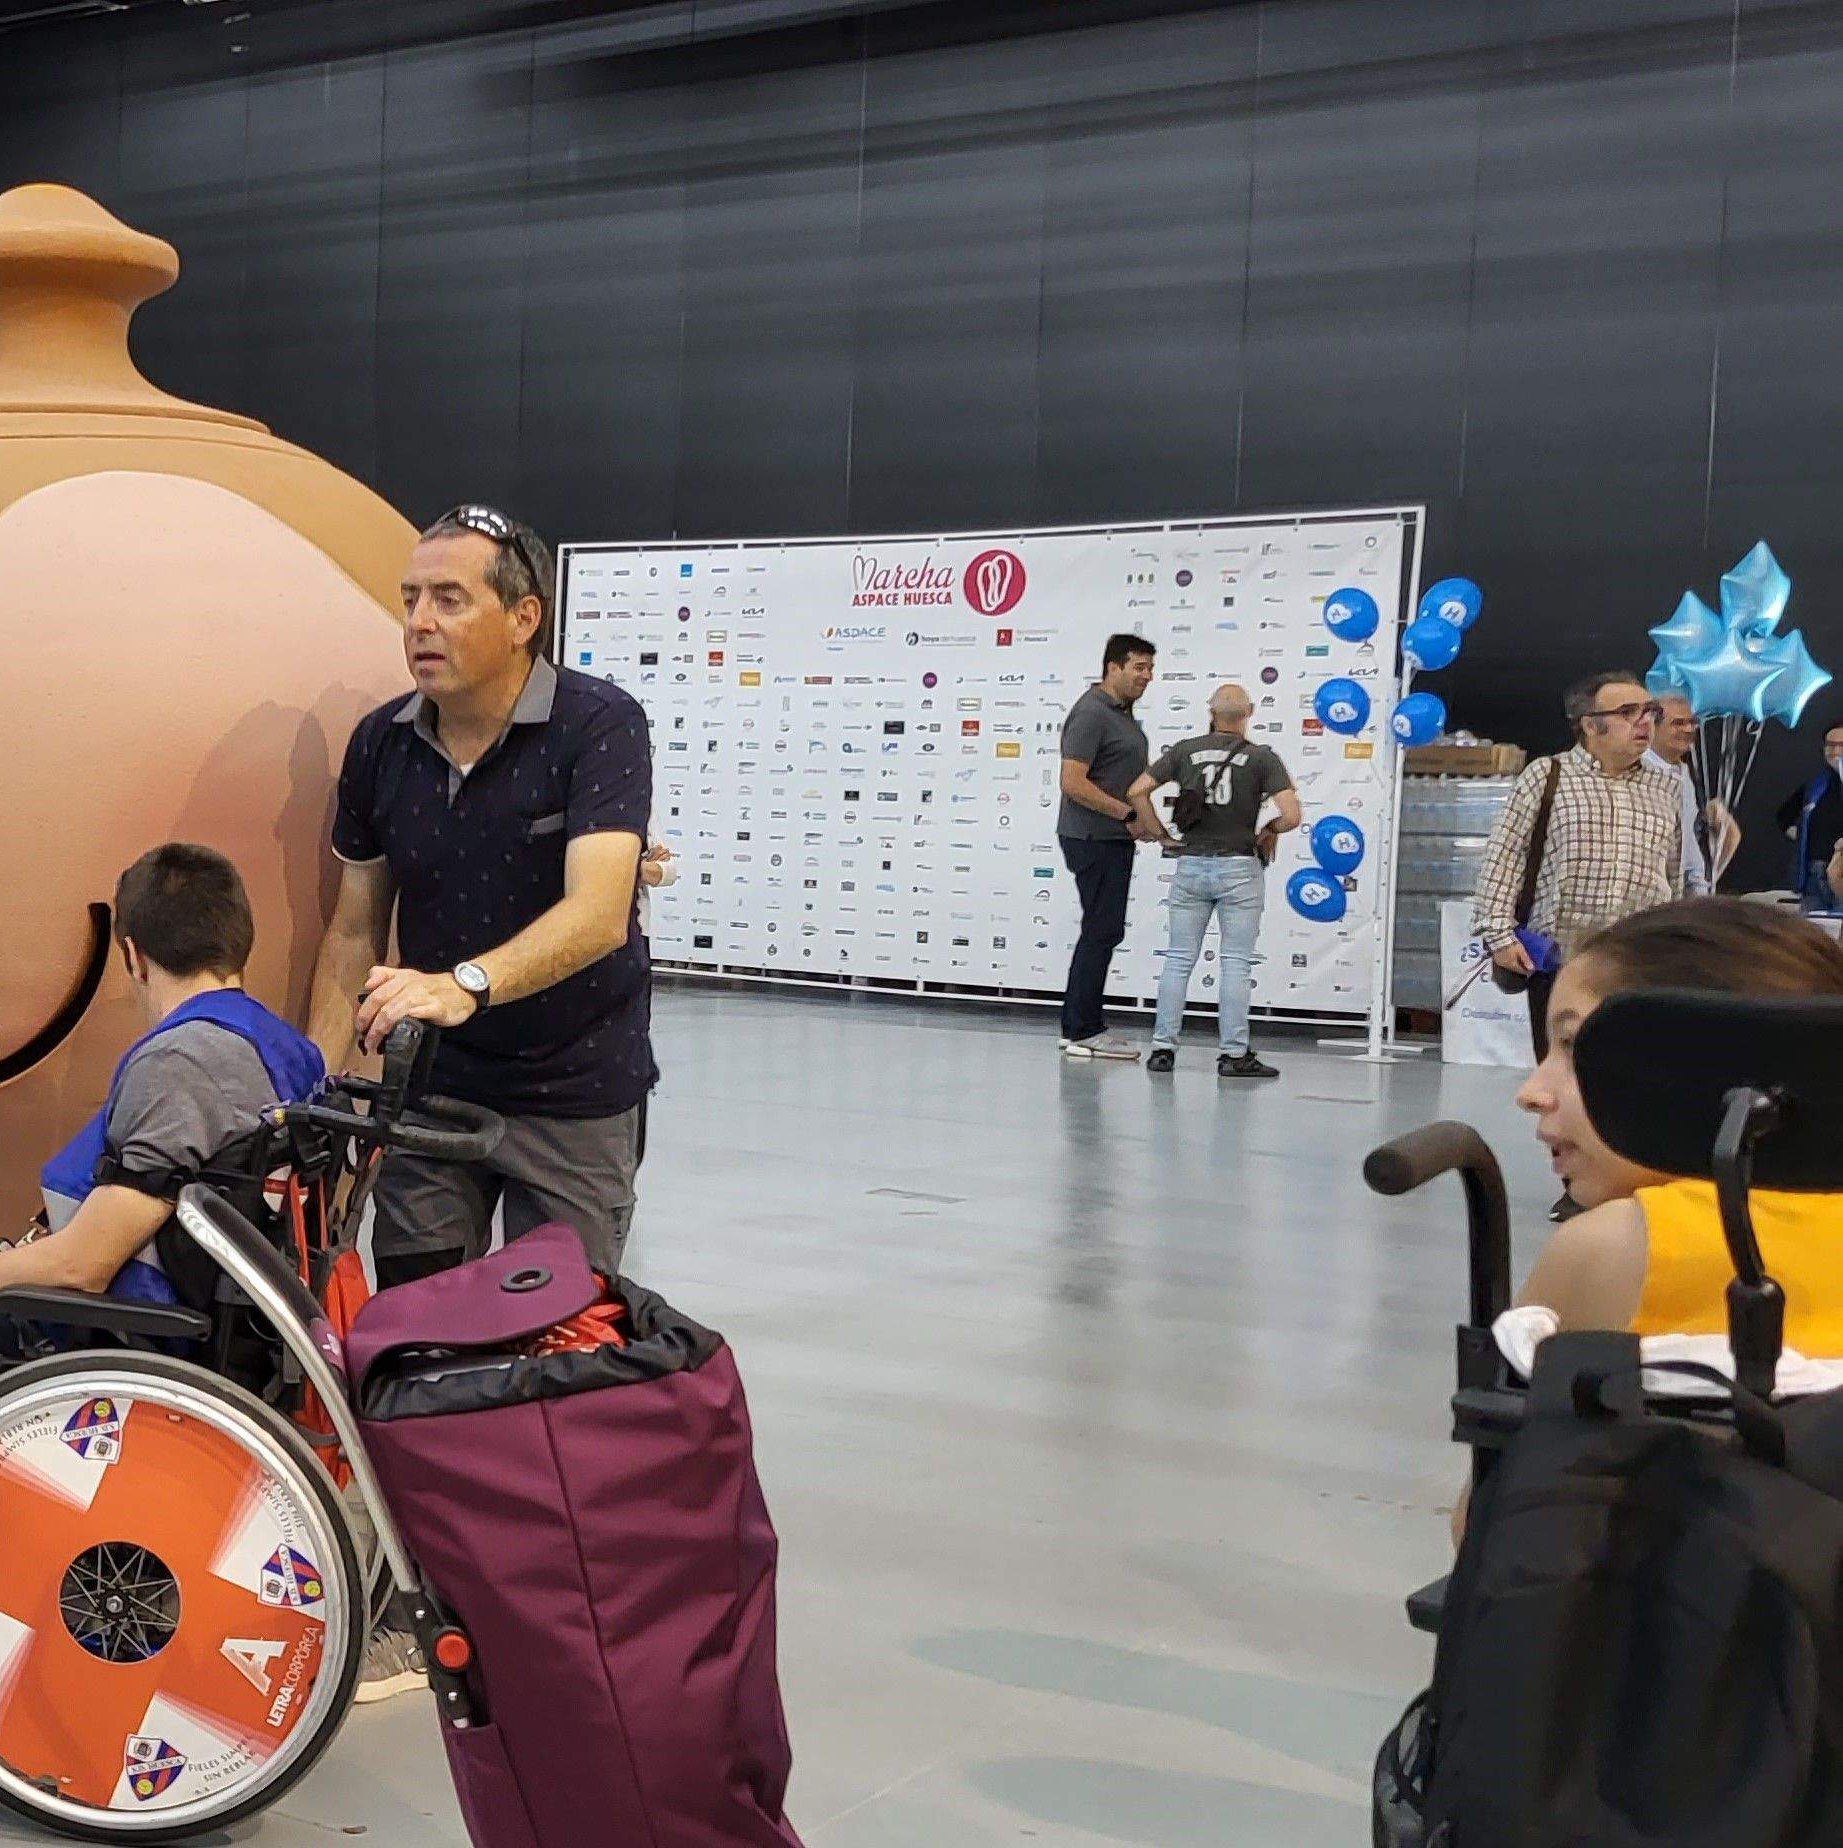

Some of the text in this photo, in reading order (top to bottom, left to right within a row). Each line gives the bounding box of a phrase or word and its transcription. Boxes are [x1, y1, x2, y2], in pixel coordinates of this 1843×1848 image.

[853, 555, 955, 590] Marcha
[852, 591, 953, 606] ASPACE HUESCA
[219, 1637, 290, 1697] A
